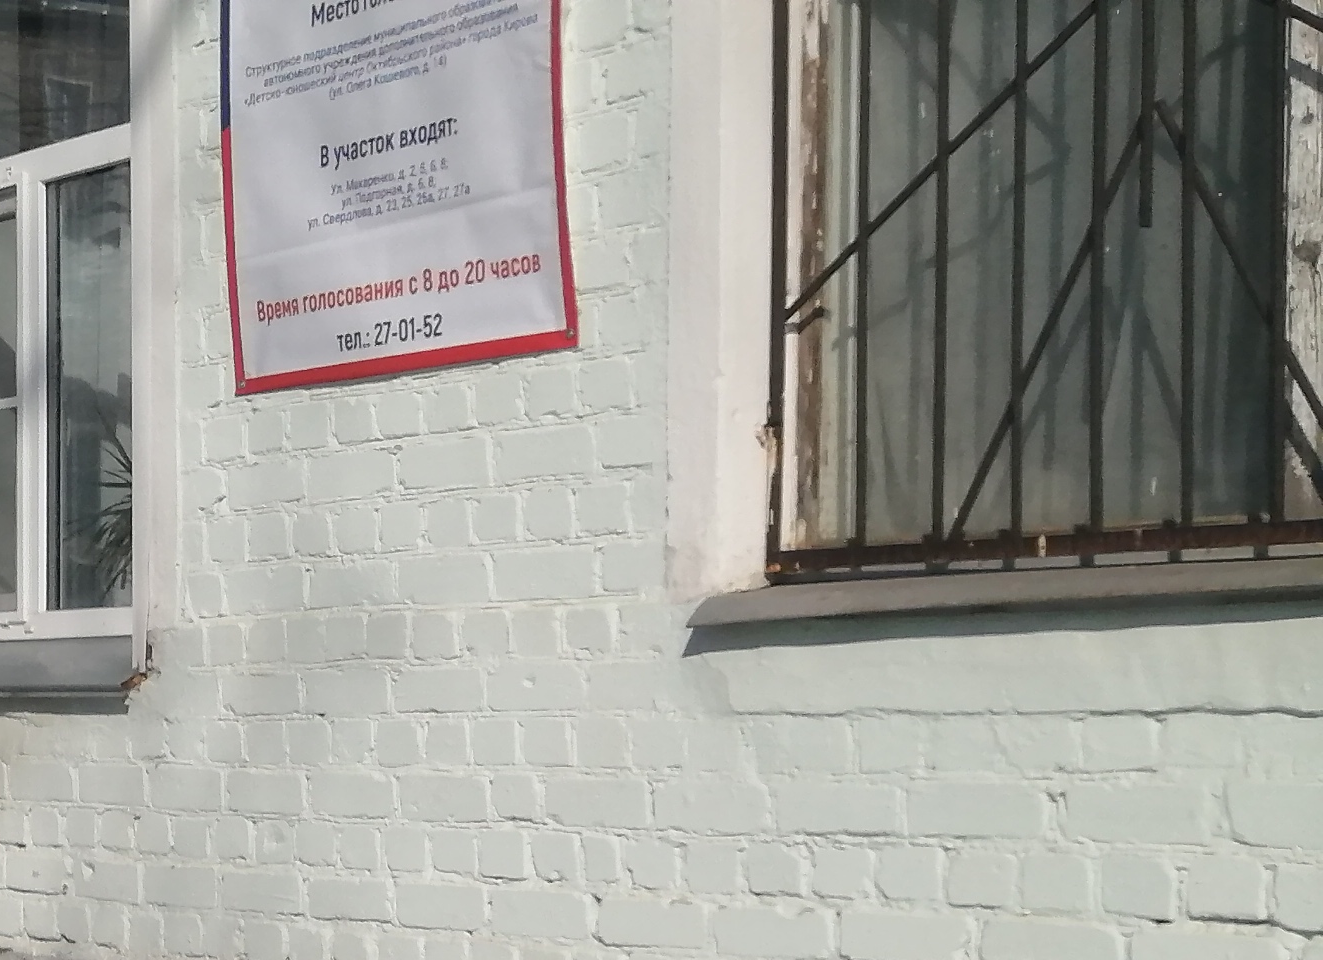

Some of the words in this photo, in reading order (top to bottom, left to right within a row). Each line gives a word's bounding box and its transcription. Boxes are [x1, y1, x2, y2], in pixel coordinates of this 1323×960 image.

[320, 145, 330, 168] В
[334, 132, 395, 170] участок
[400, 117, 458, 149] входят:
[257, 297, 299, 326] Время
[302, 279, 403, 315] голосования
[408, 277, 418, 295] с
[422, 268, 434, 293] 8
[438, 269, 460, 294] до
[465, 258, 487, 286] 20
[490, 253, 542, 280] часов
[336, 330, 370, 352] тел.:
[374, 312, 443, 347] 27-01-52
